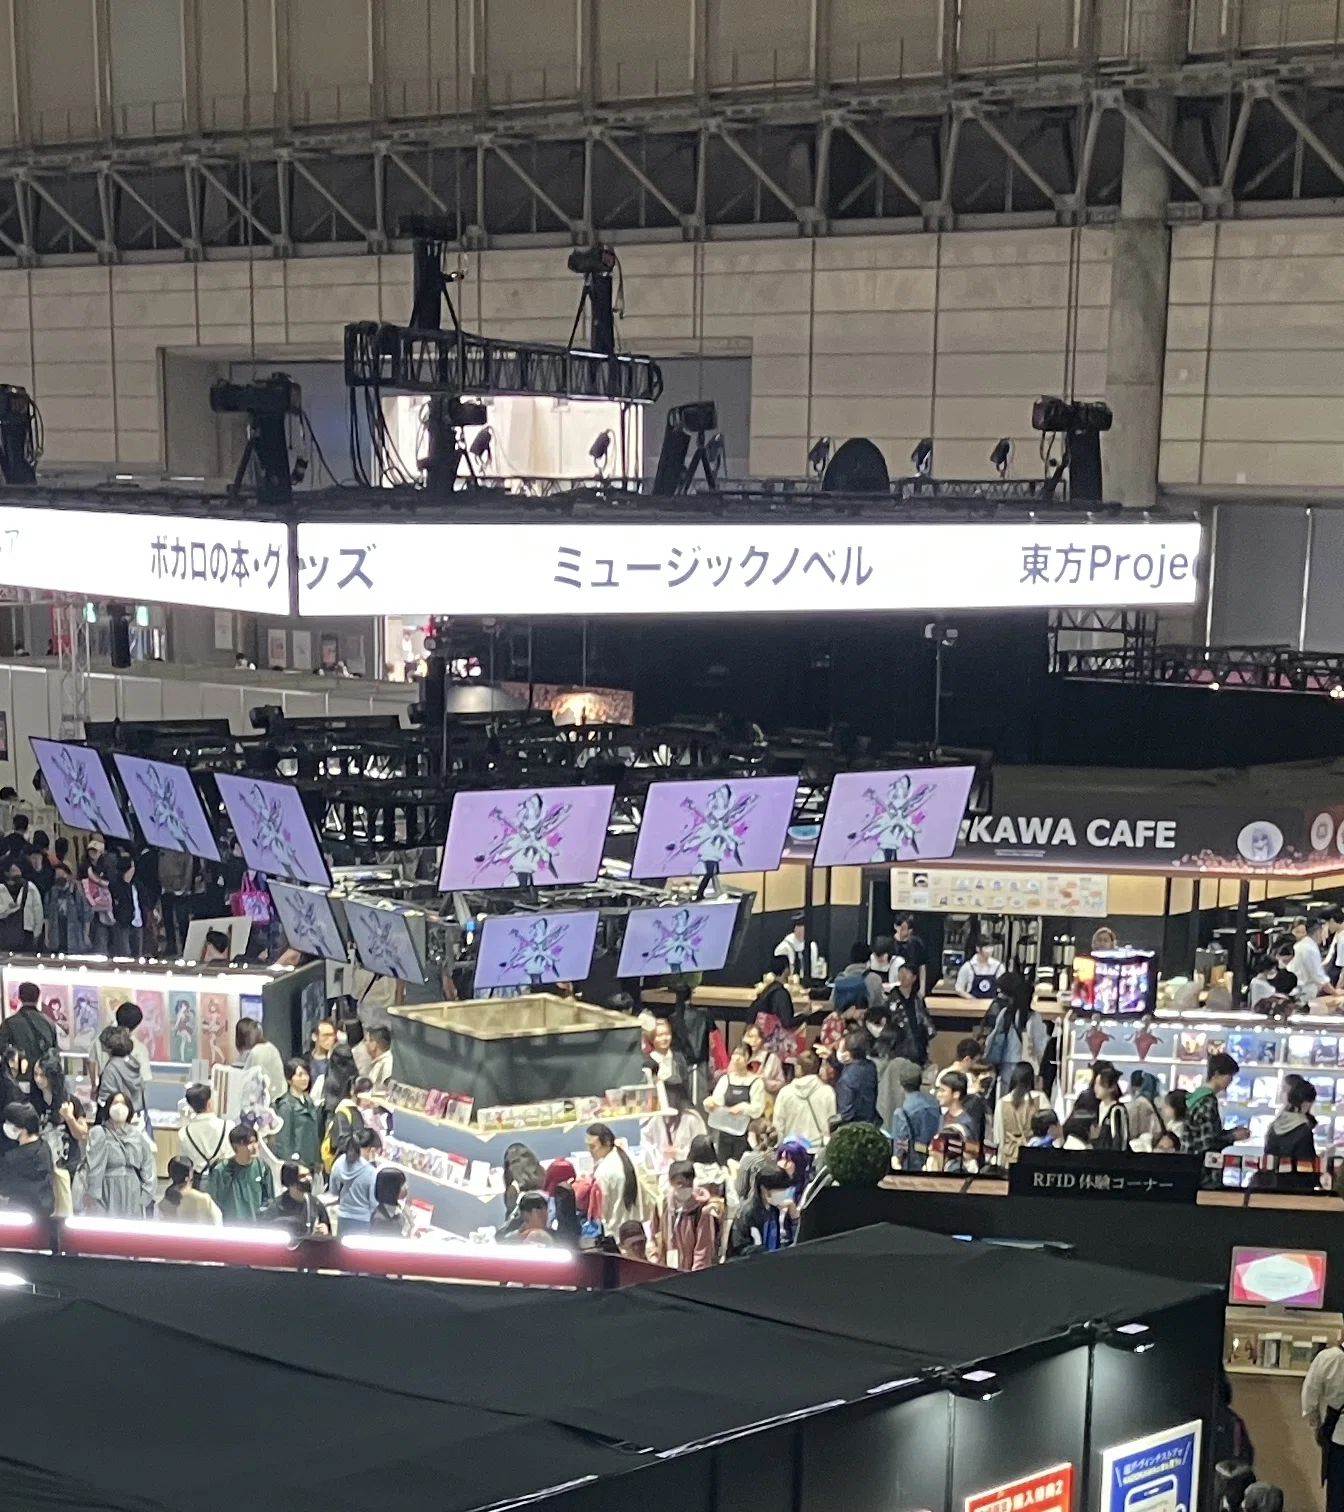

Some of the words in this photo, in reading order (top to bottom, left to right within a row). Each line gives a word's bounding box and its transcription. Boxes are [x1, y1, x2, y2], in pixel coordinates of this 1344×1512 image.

[553, 543, 874, 590] ミュージックノベル
[1086, 818, 1177, 849] CAFE
[1033, 1171, 1076, 1188] RFID
[1079, 1173, 1174, 1192] 体験コーナー
